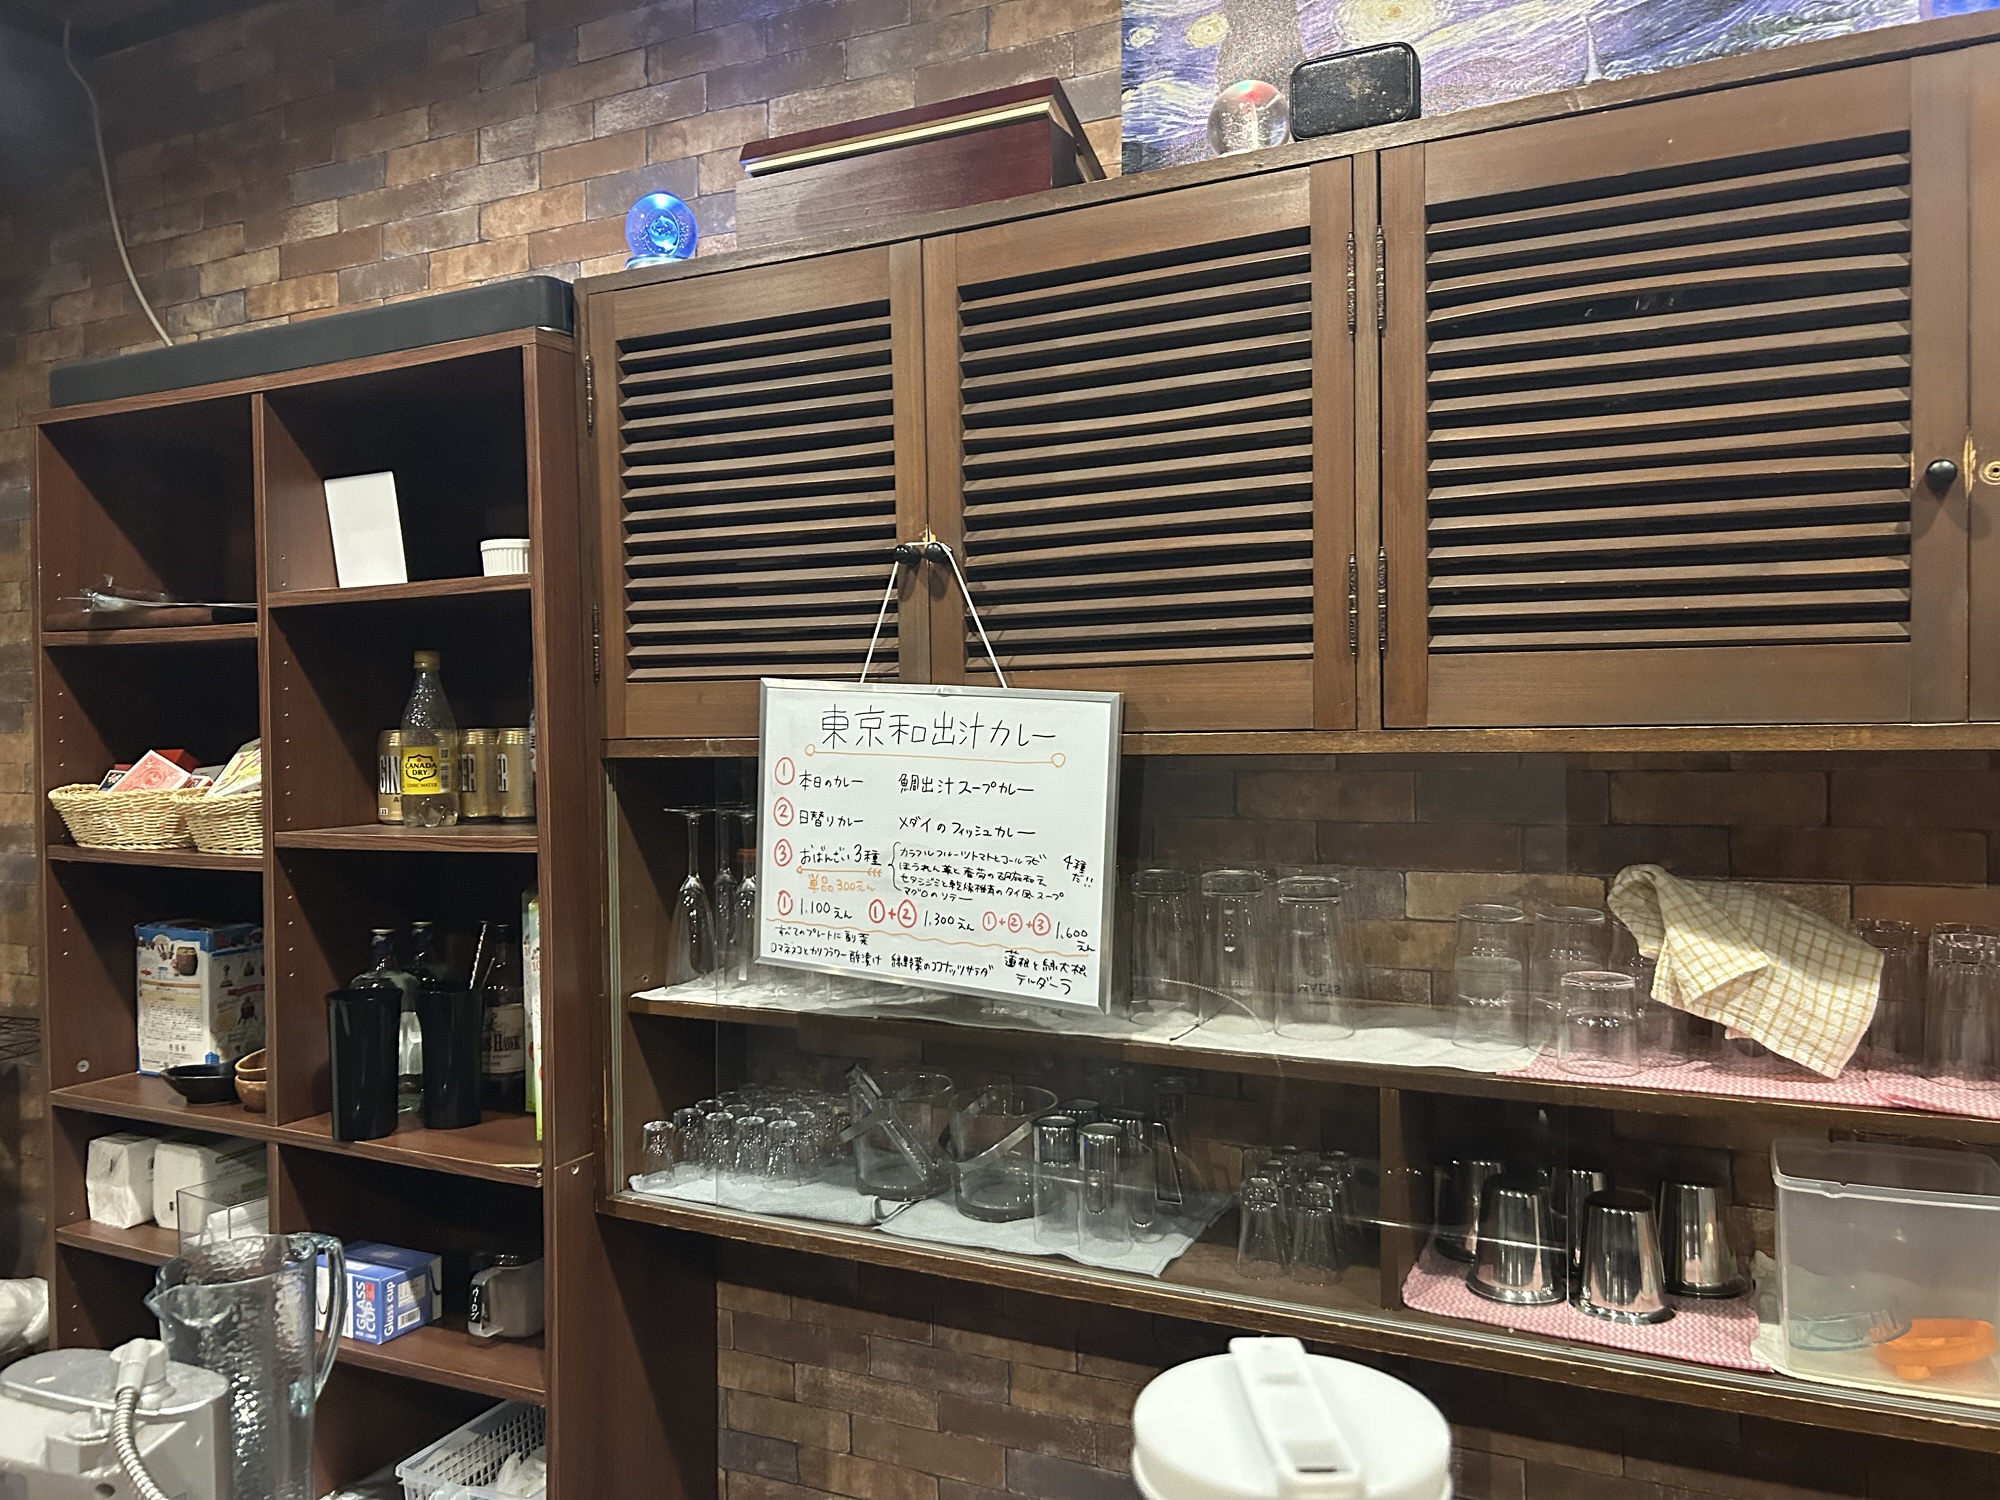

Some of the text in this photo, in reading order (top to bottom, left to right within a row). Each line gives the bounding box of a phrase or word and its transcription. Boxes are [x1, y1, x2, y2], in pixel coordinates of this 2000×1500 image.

[821, 704, 1056, 749] 東京和出汁カレー
[405, 762, 437, 770] CANADA
[799, 770, 864, 788] 本日のカレー
[799, 810, 864, 827] 日替りカレー
[356, 1281, 366, 1329] GLASS
[366, 1301, 376, 1332] CUP
[384, 1281, 396, 1337] Glass cup
